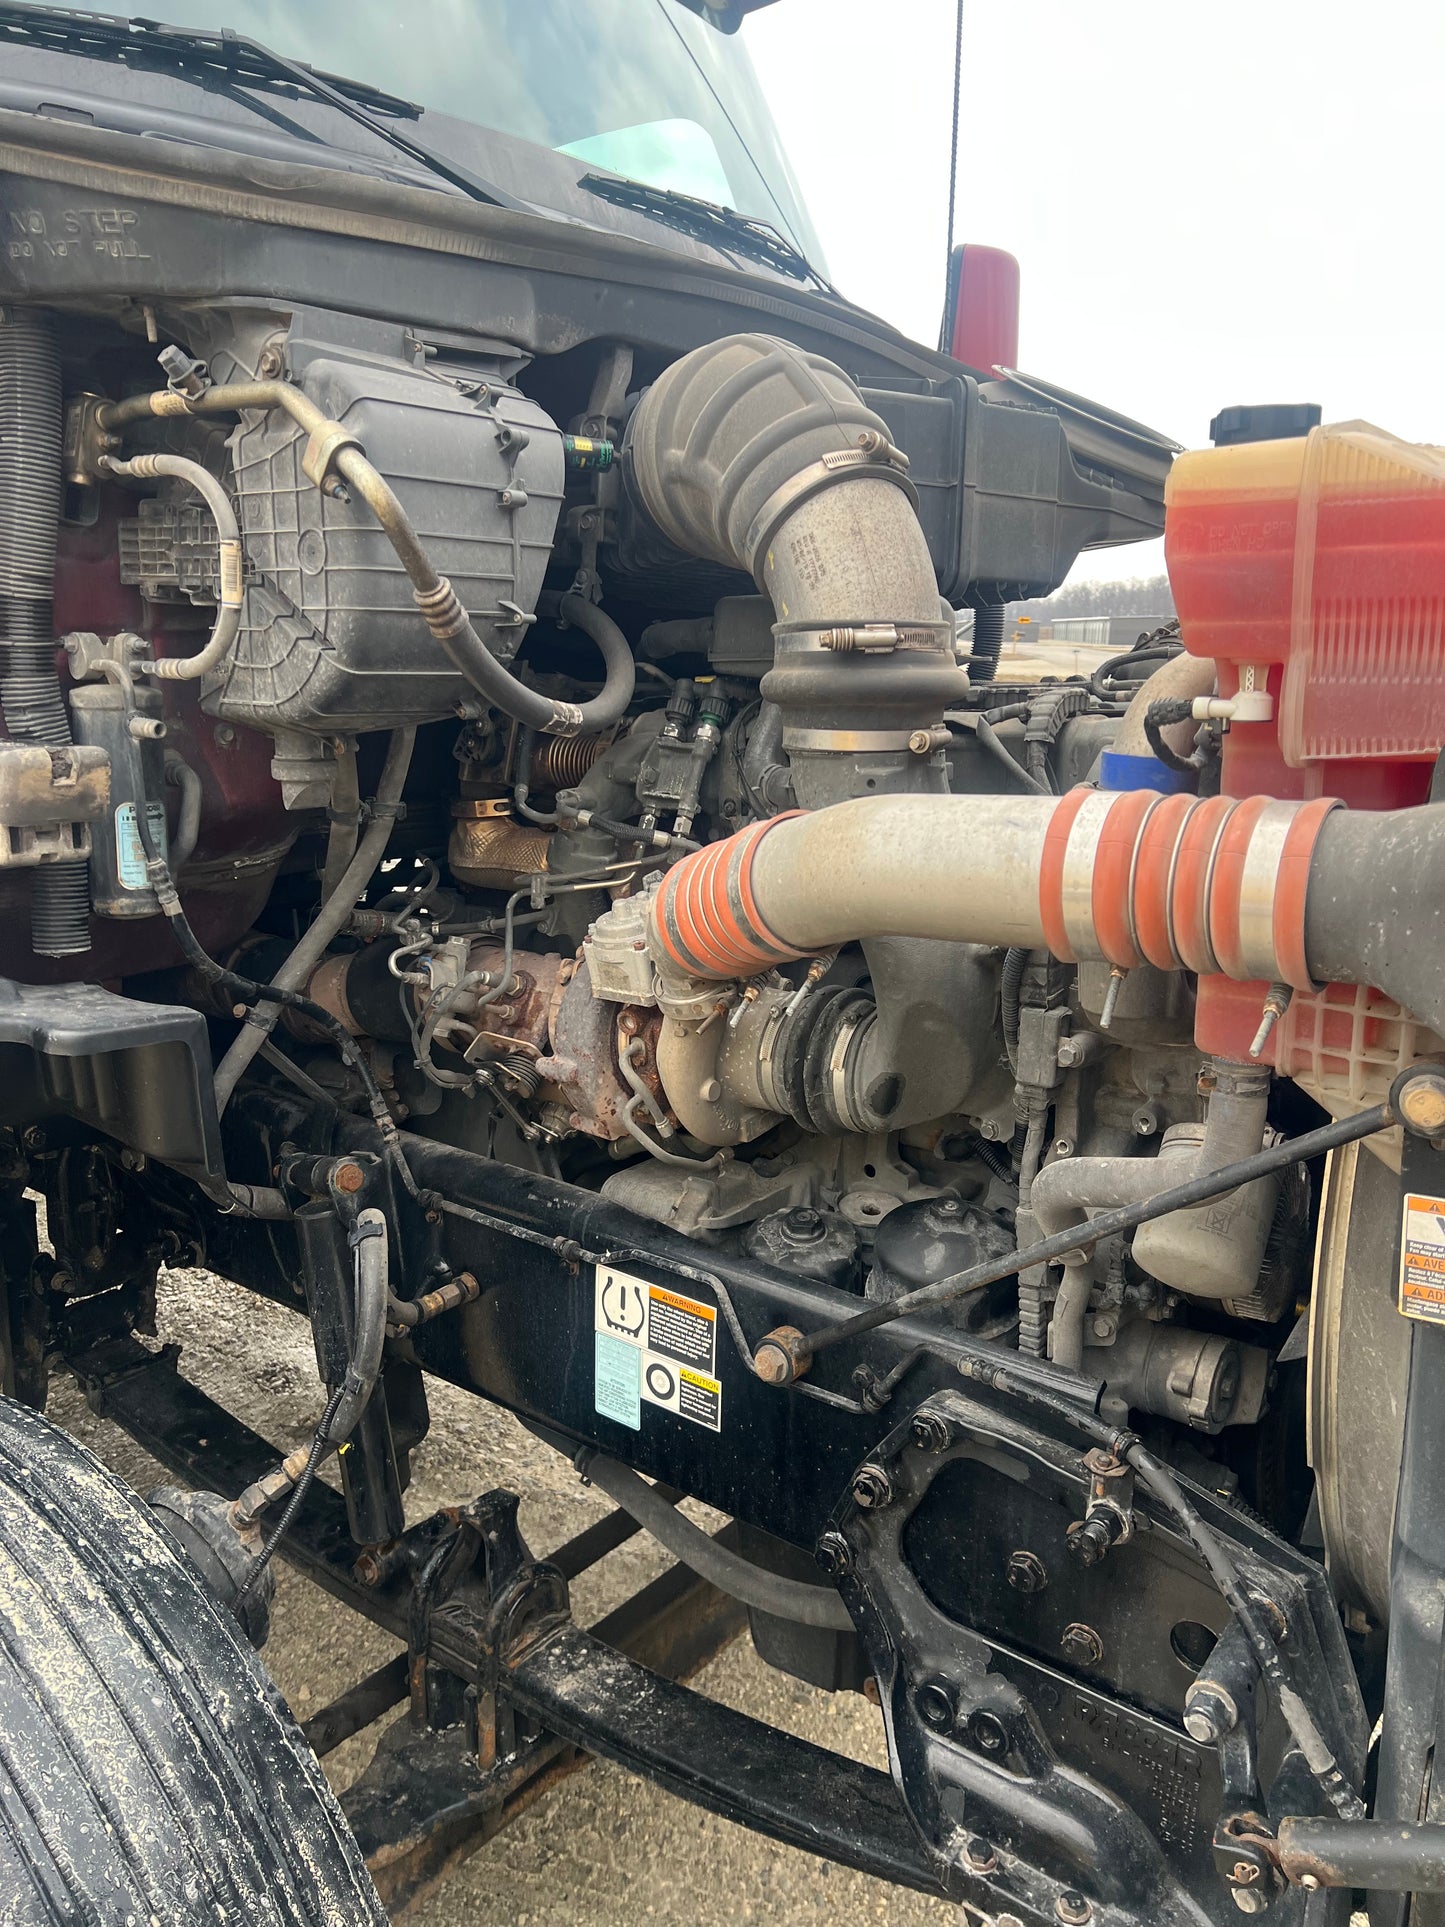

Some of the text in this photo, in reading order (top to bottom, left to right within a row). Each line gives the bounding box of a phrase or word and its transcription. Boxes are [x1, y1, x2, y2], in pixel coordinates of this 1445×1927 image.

[9, 208, 140, 236] NO STEP
[93, 239, 152, 259] PULL
[668, 1296, 701, 1313] WARNING
[686, 1372, 719, 1391] CAUTION
